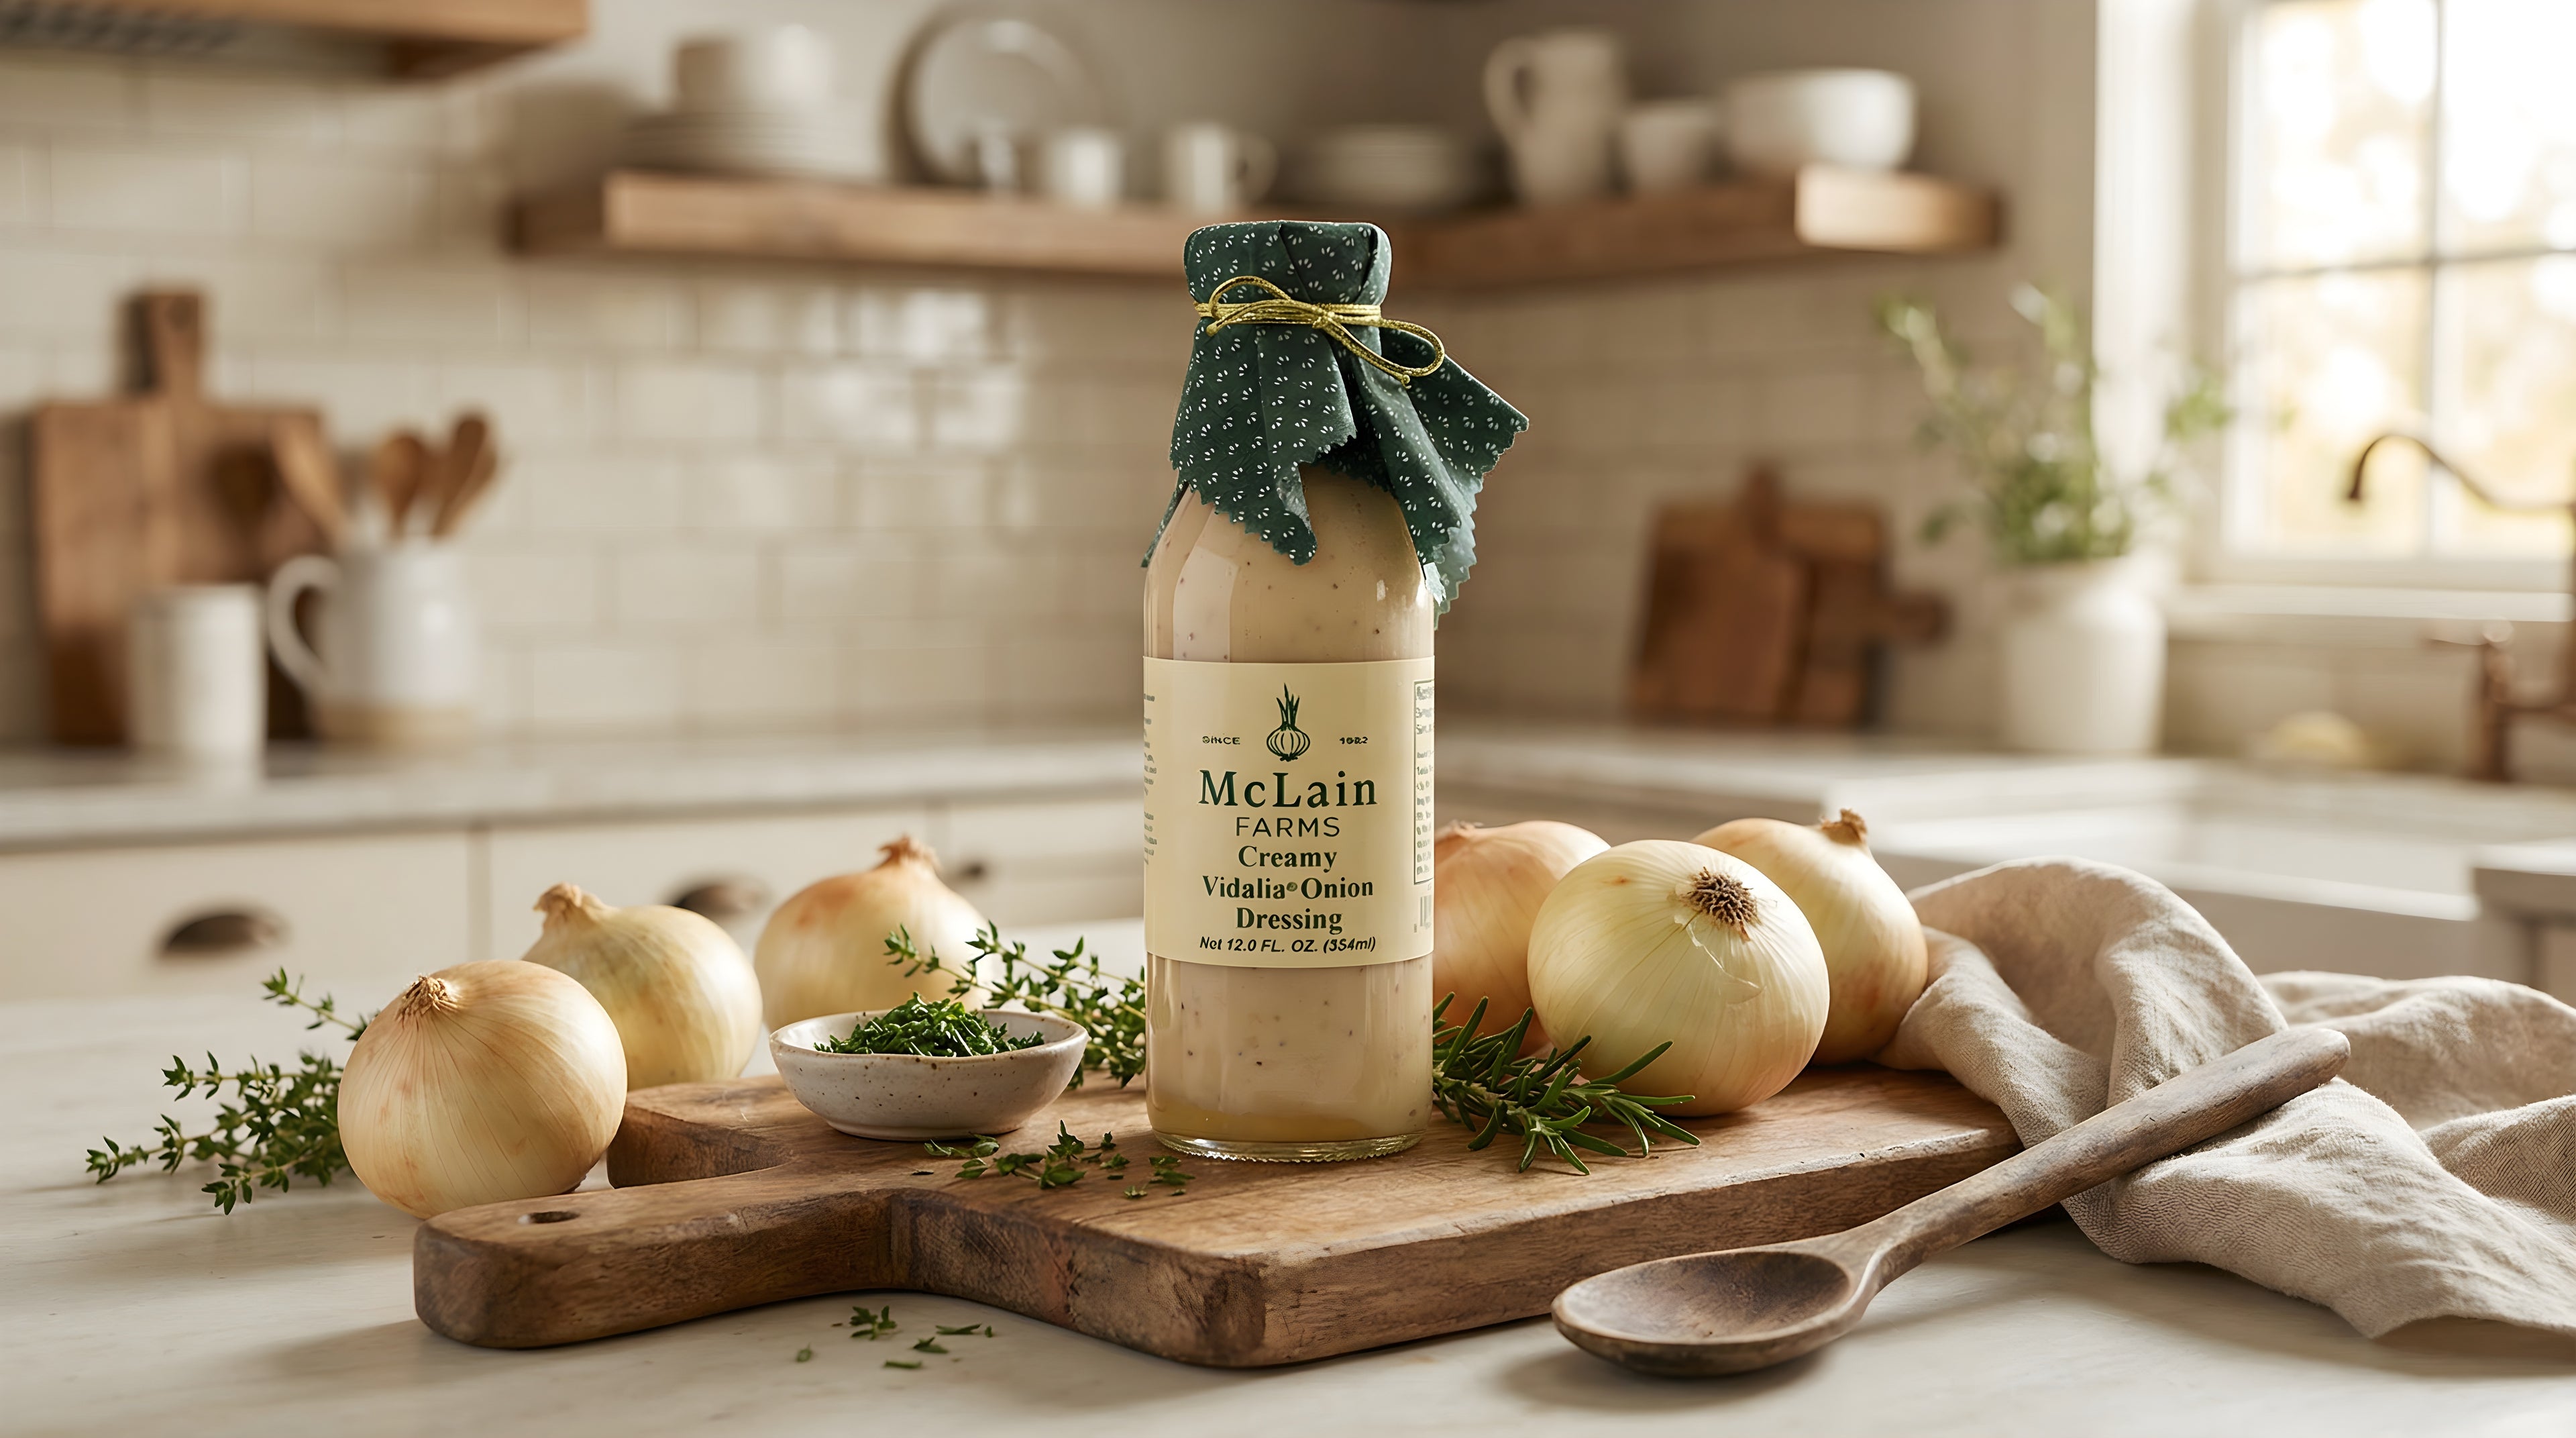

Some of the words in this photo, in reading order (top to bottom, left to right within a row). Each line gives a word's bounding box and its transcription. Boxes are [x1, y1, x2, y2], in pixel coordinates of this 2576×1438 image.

[1198, 770, 1378, 809] McLain
[1236, 816, 1340, 837] FARMS
[1238, 845, 1338, 873] Creamy
[1300, 876, 1373, 900] Onion
[1236, 907, 1343, 935] Dressing
[1199, 936, 1222, 950] Net
[1227, 938, 1257, 952] 12.0
[1260, 939, 1285, 953] FL.
[1291, 939, 1318, 953] OZ.
